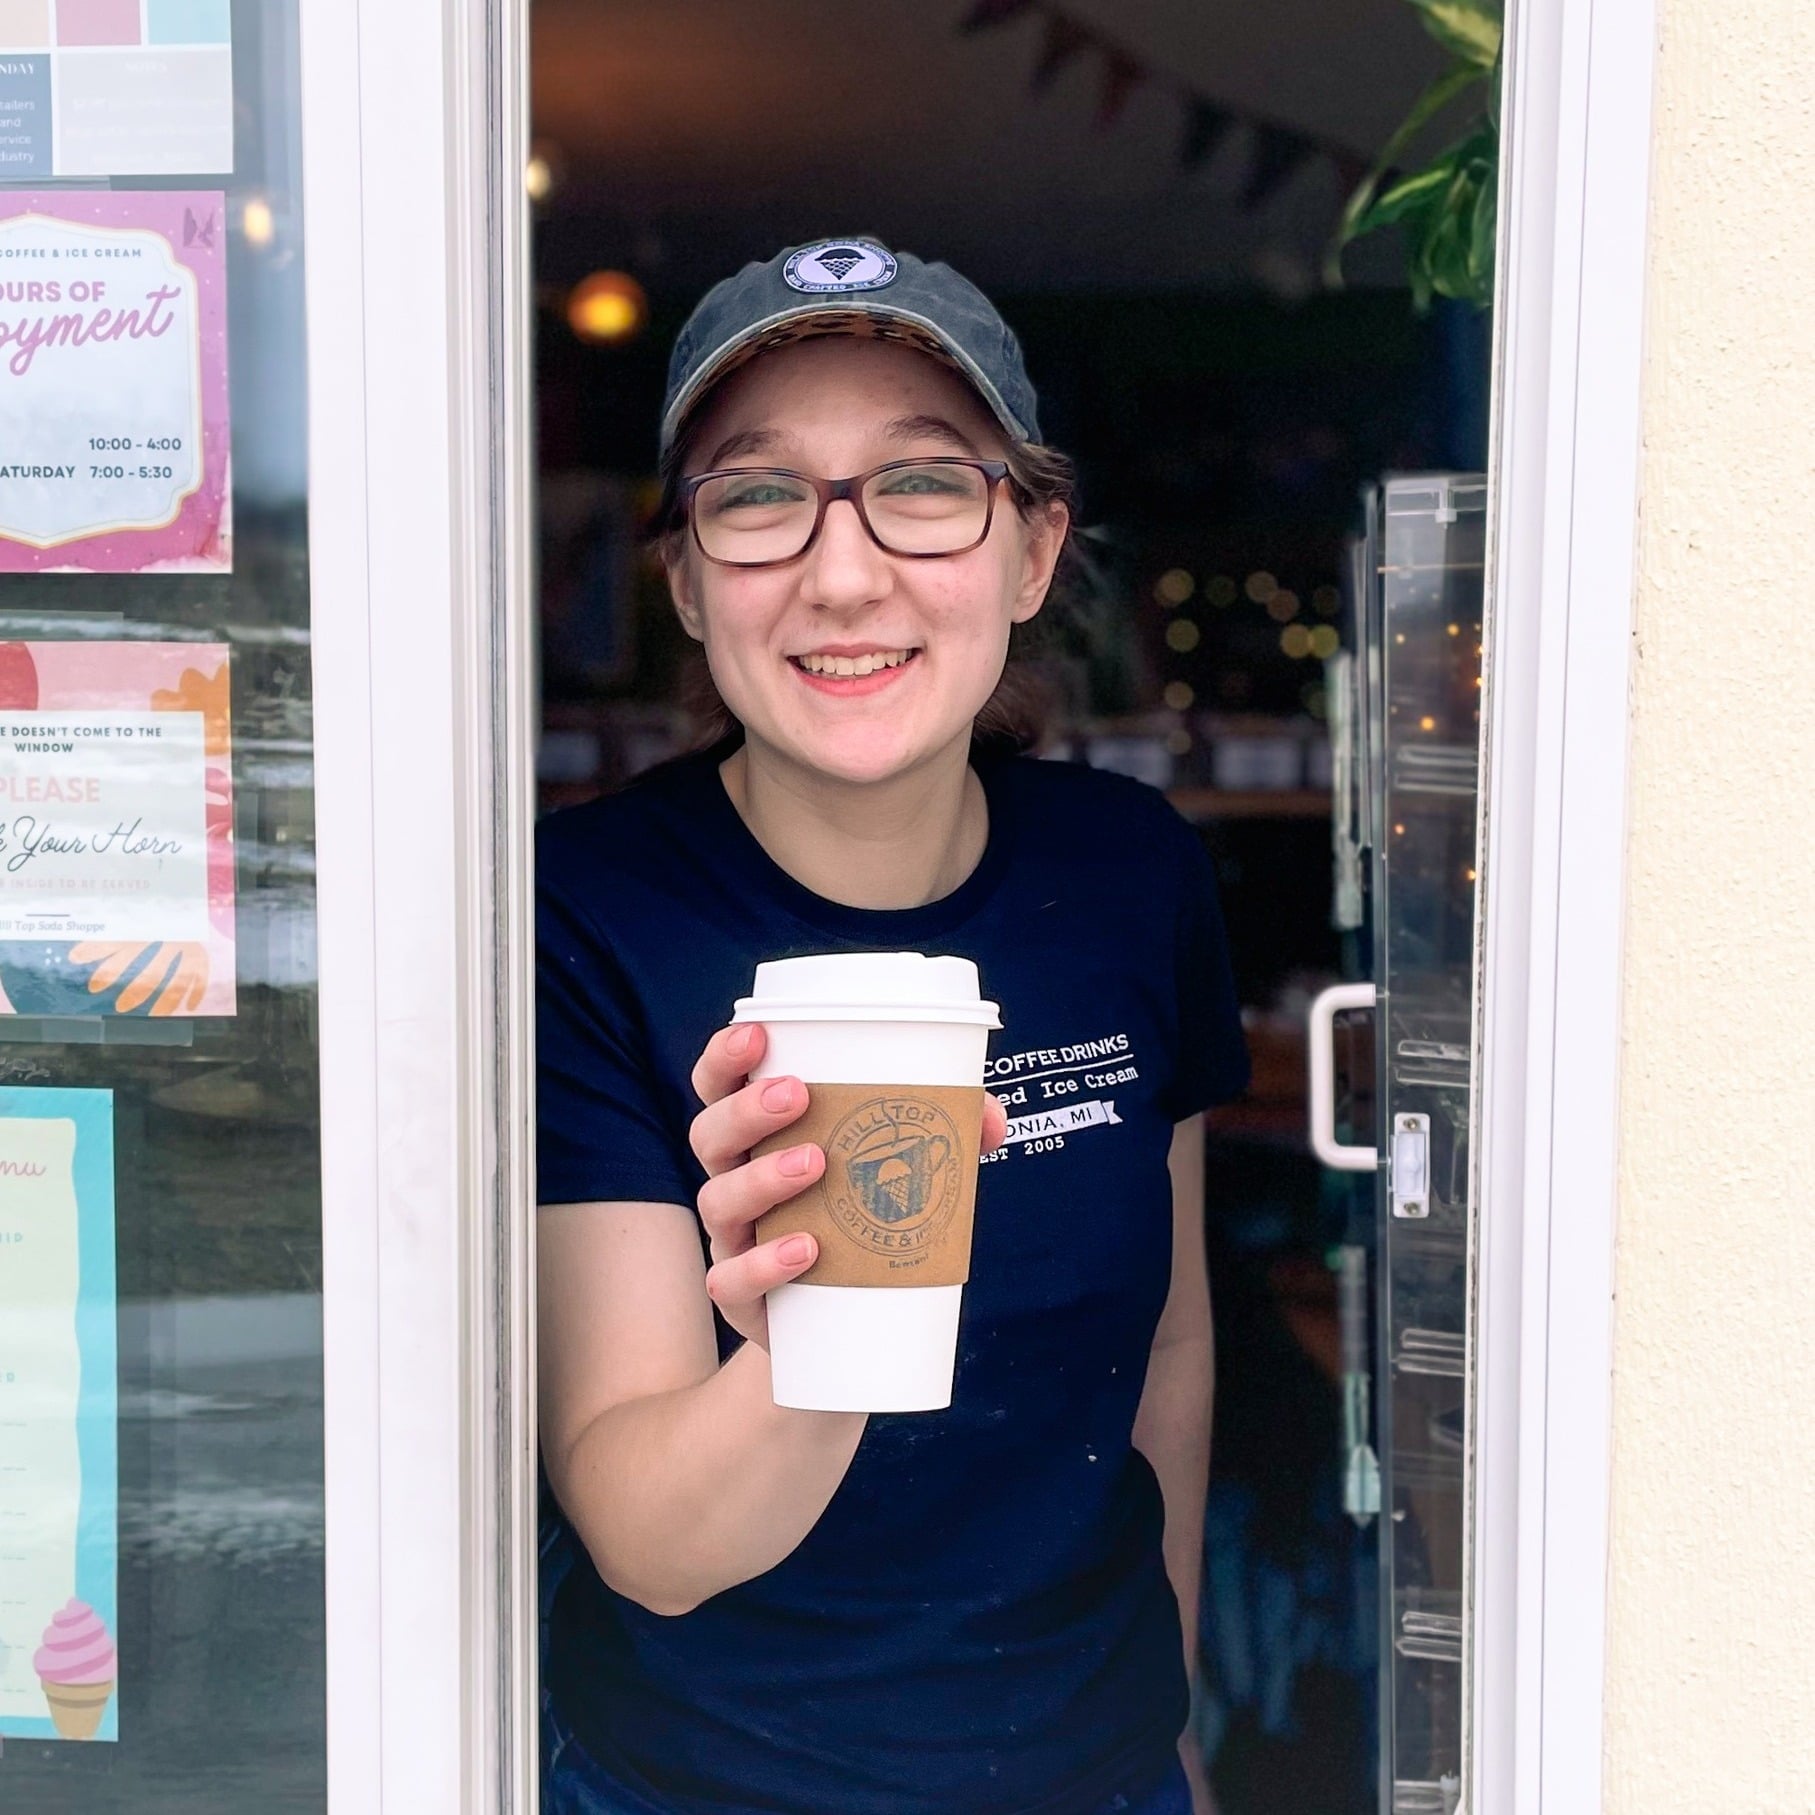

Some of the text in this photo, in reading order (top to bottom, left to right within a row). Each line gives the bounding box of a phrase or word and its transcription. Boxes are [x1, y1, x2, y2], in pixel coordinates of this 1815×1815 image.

[66, 248, 88, 258] ICE
[94, 248, 142, 258] CREAM
[0, 281, 106, 302] URS OF
[89, 438, 132, 450] 10:00
[146, 438, 182, 450] 4:00
[90, 466, 124, 478] 7:00
[139, 466, 173, 478] 5:30
[12, 726, 68, 737] DOESN'T
[73, 727, 110, 737] COME
[115, 727, 133, 737] TO
[138, 727, 162, 737] THE
[14, 742, 74, 753] WINDOW
[7, 815, 87, 872] Your
[91, 817, 183, 855] Horn
[15, 920, 35, 933] Top
[66, 920, 106, 933] Shoppe
[1060, 1034, 1129, 1063] DRINKS
[1041, 1078, 1079, 1099] Ice
[1084, 1066, 1139, 1090] Cream
[1070, 1107, 1093, 1125] MI
[837, 1105, 935, 1151] HILL TOP
[1024, 1135, 1065, 1155] 2005
